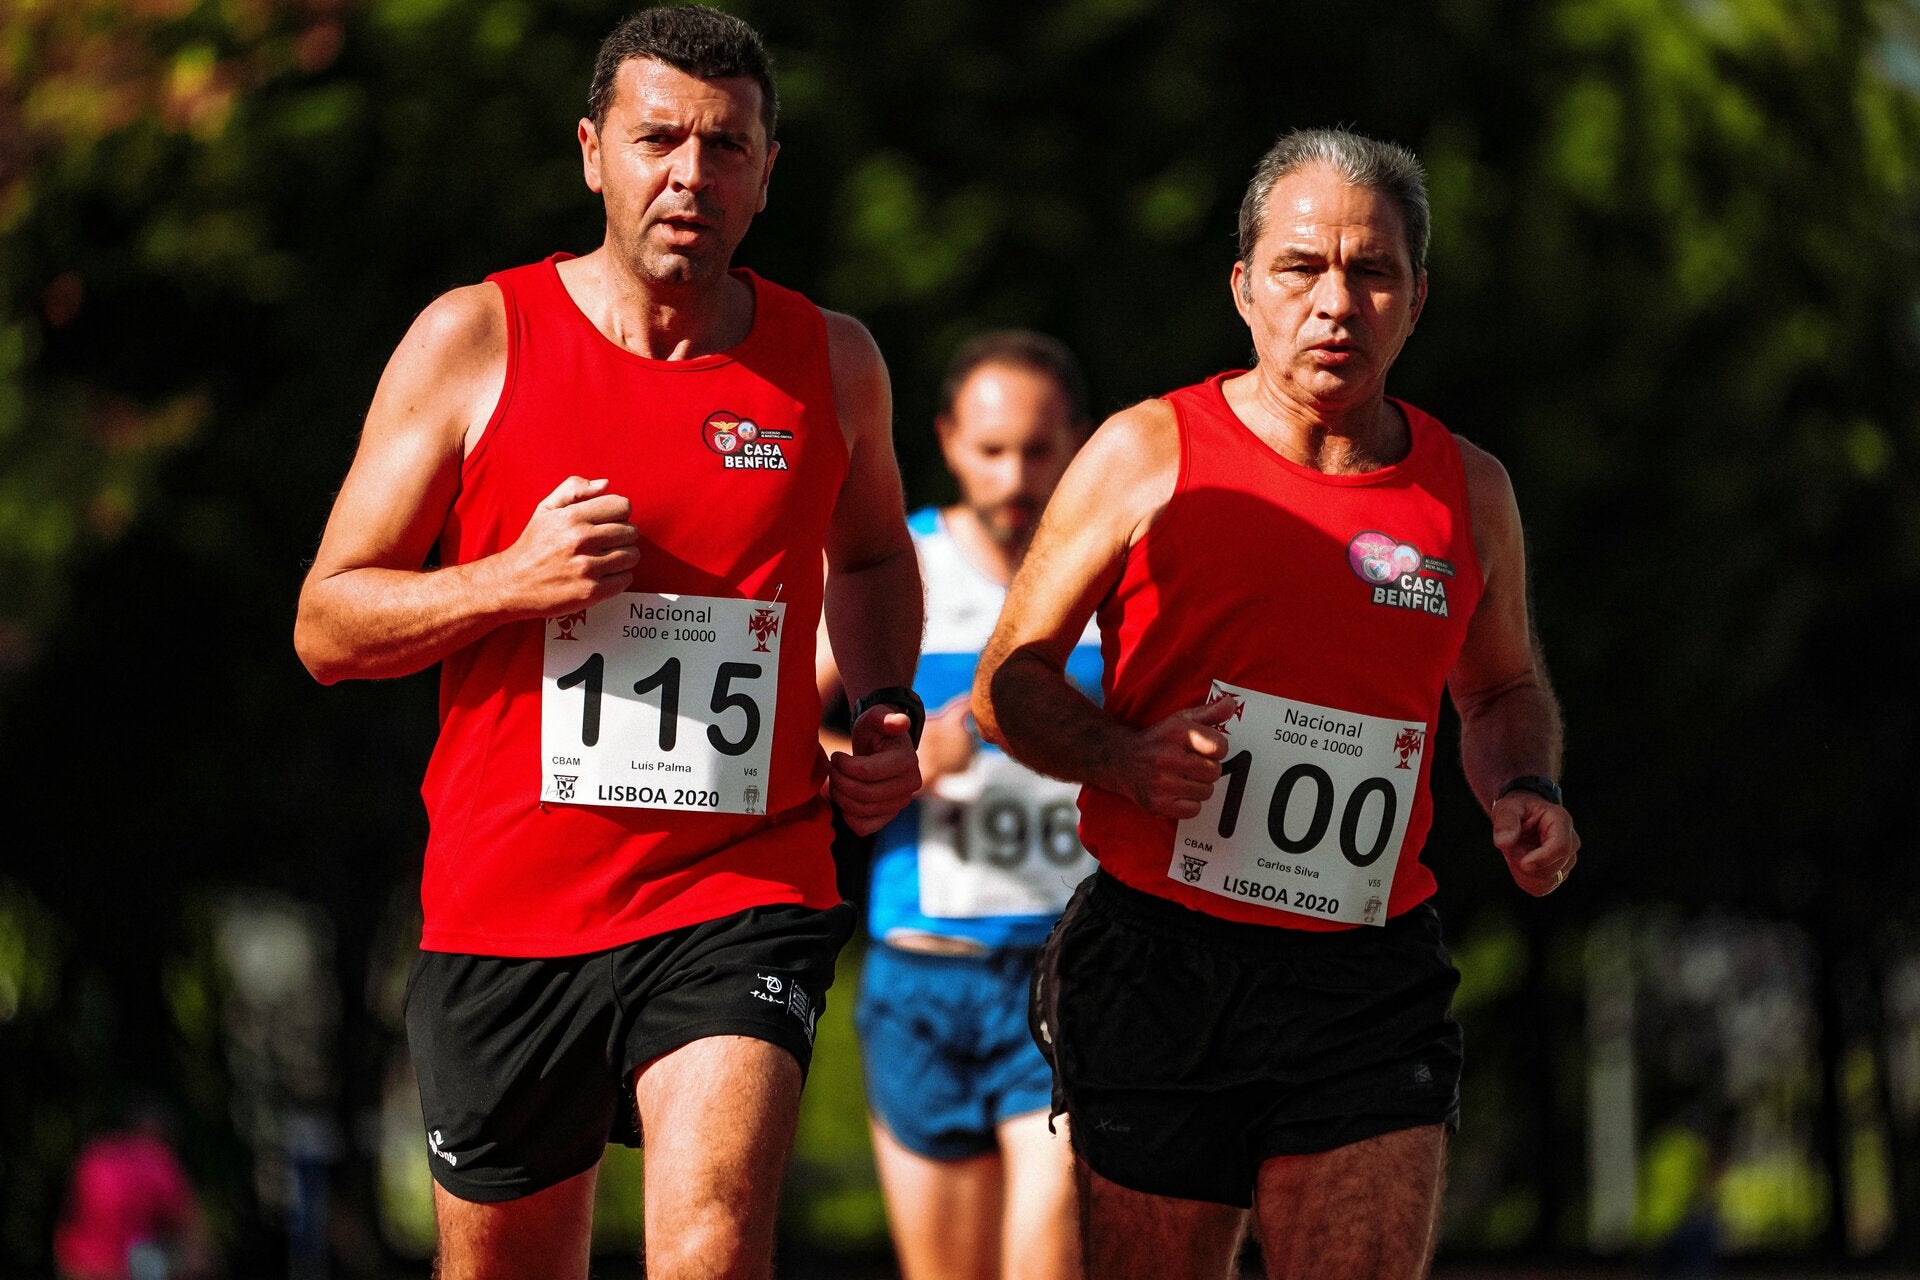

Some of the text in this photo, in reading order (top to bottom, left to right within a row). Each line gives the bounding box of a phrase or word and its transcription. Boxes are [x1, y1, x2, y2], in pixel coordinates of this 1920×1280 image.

[744, 443, 782, 456] CASA
[724, 456, 787, 470] BENFICA
[1400, 574, 1446, 598] CASA
[629, 602, 712, 624] Nacional
[1373, 587, 1449, 617] BENFICA
[622, 625, 716, 643] 5000 e 10000
[556, 652, 763, 757] 115
[1284, 708, 1363, 739] Nacional
[1273, 728, 1363, 758] 5000 e 10000
[552, 756, 581, 766] CBAM
[657, 761, 692, 773] Palma
[743, 767, 758, 777] V45
[598, 784, 720, 808] LISBOA 2020
[1217, 749, 1398, 868] 100
[936, 798, 1085, 868] 196
[1184, 837, 1213, 853] CBAM
[1257, 857, 1320, 880] Carlos Silva
[1222, 875, 1340, 915] LISBOA 2020
[1368, 879, 1381, 888] V55
